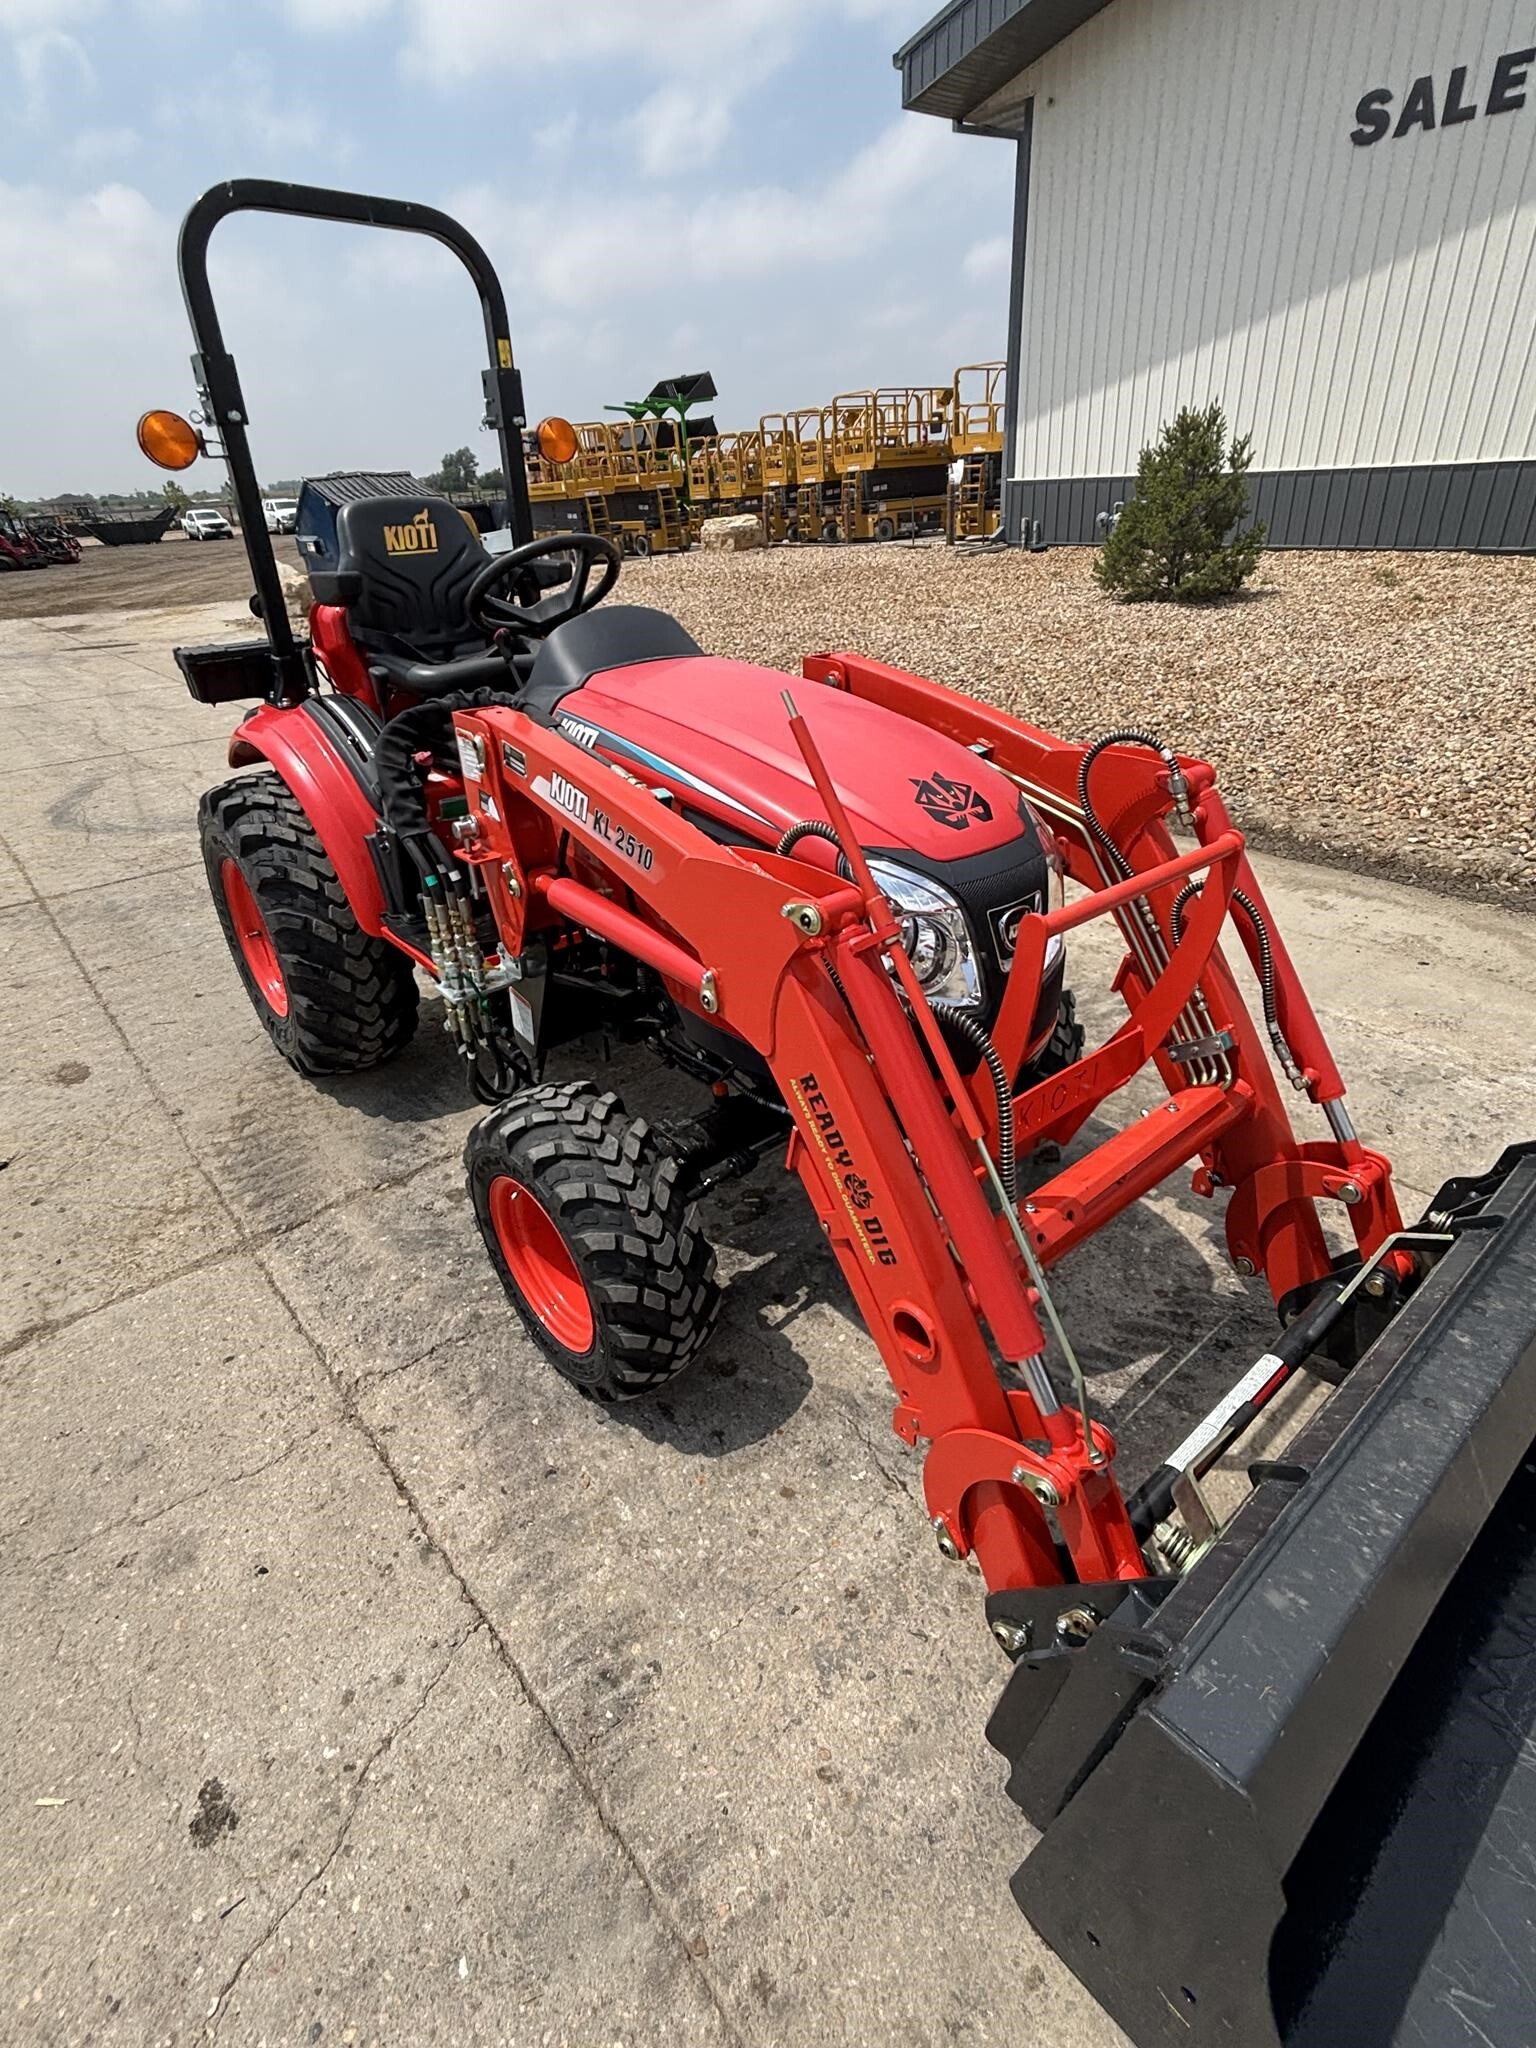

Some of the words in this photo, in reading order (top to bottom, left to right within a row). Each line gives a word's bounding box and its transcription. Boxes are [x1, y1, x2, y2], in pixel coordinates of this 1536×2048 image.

[1350, 47, 1536, 146] SALE
[383, 522, 438, 551] KIOTI
[550, 770, 589, 824] KIOTI
[593, 808, 612, 841] KL
[615, 825, 653, 871] 2510
[789, 1078, 811, 1119] ALWAYS
[808, 1120, 828, 1153] READY
[825, 1155, 834, 1170] TO
[1018, 1061, 1099, 1128] KIOTI
[800, 1072, 854, 1168] READY
[863, 1216, 897, 1265] DIG
